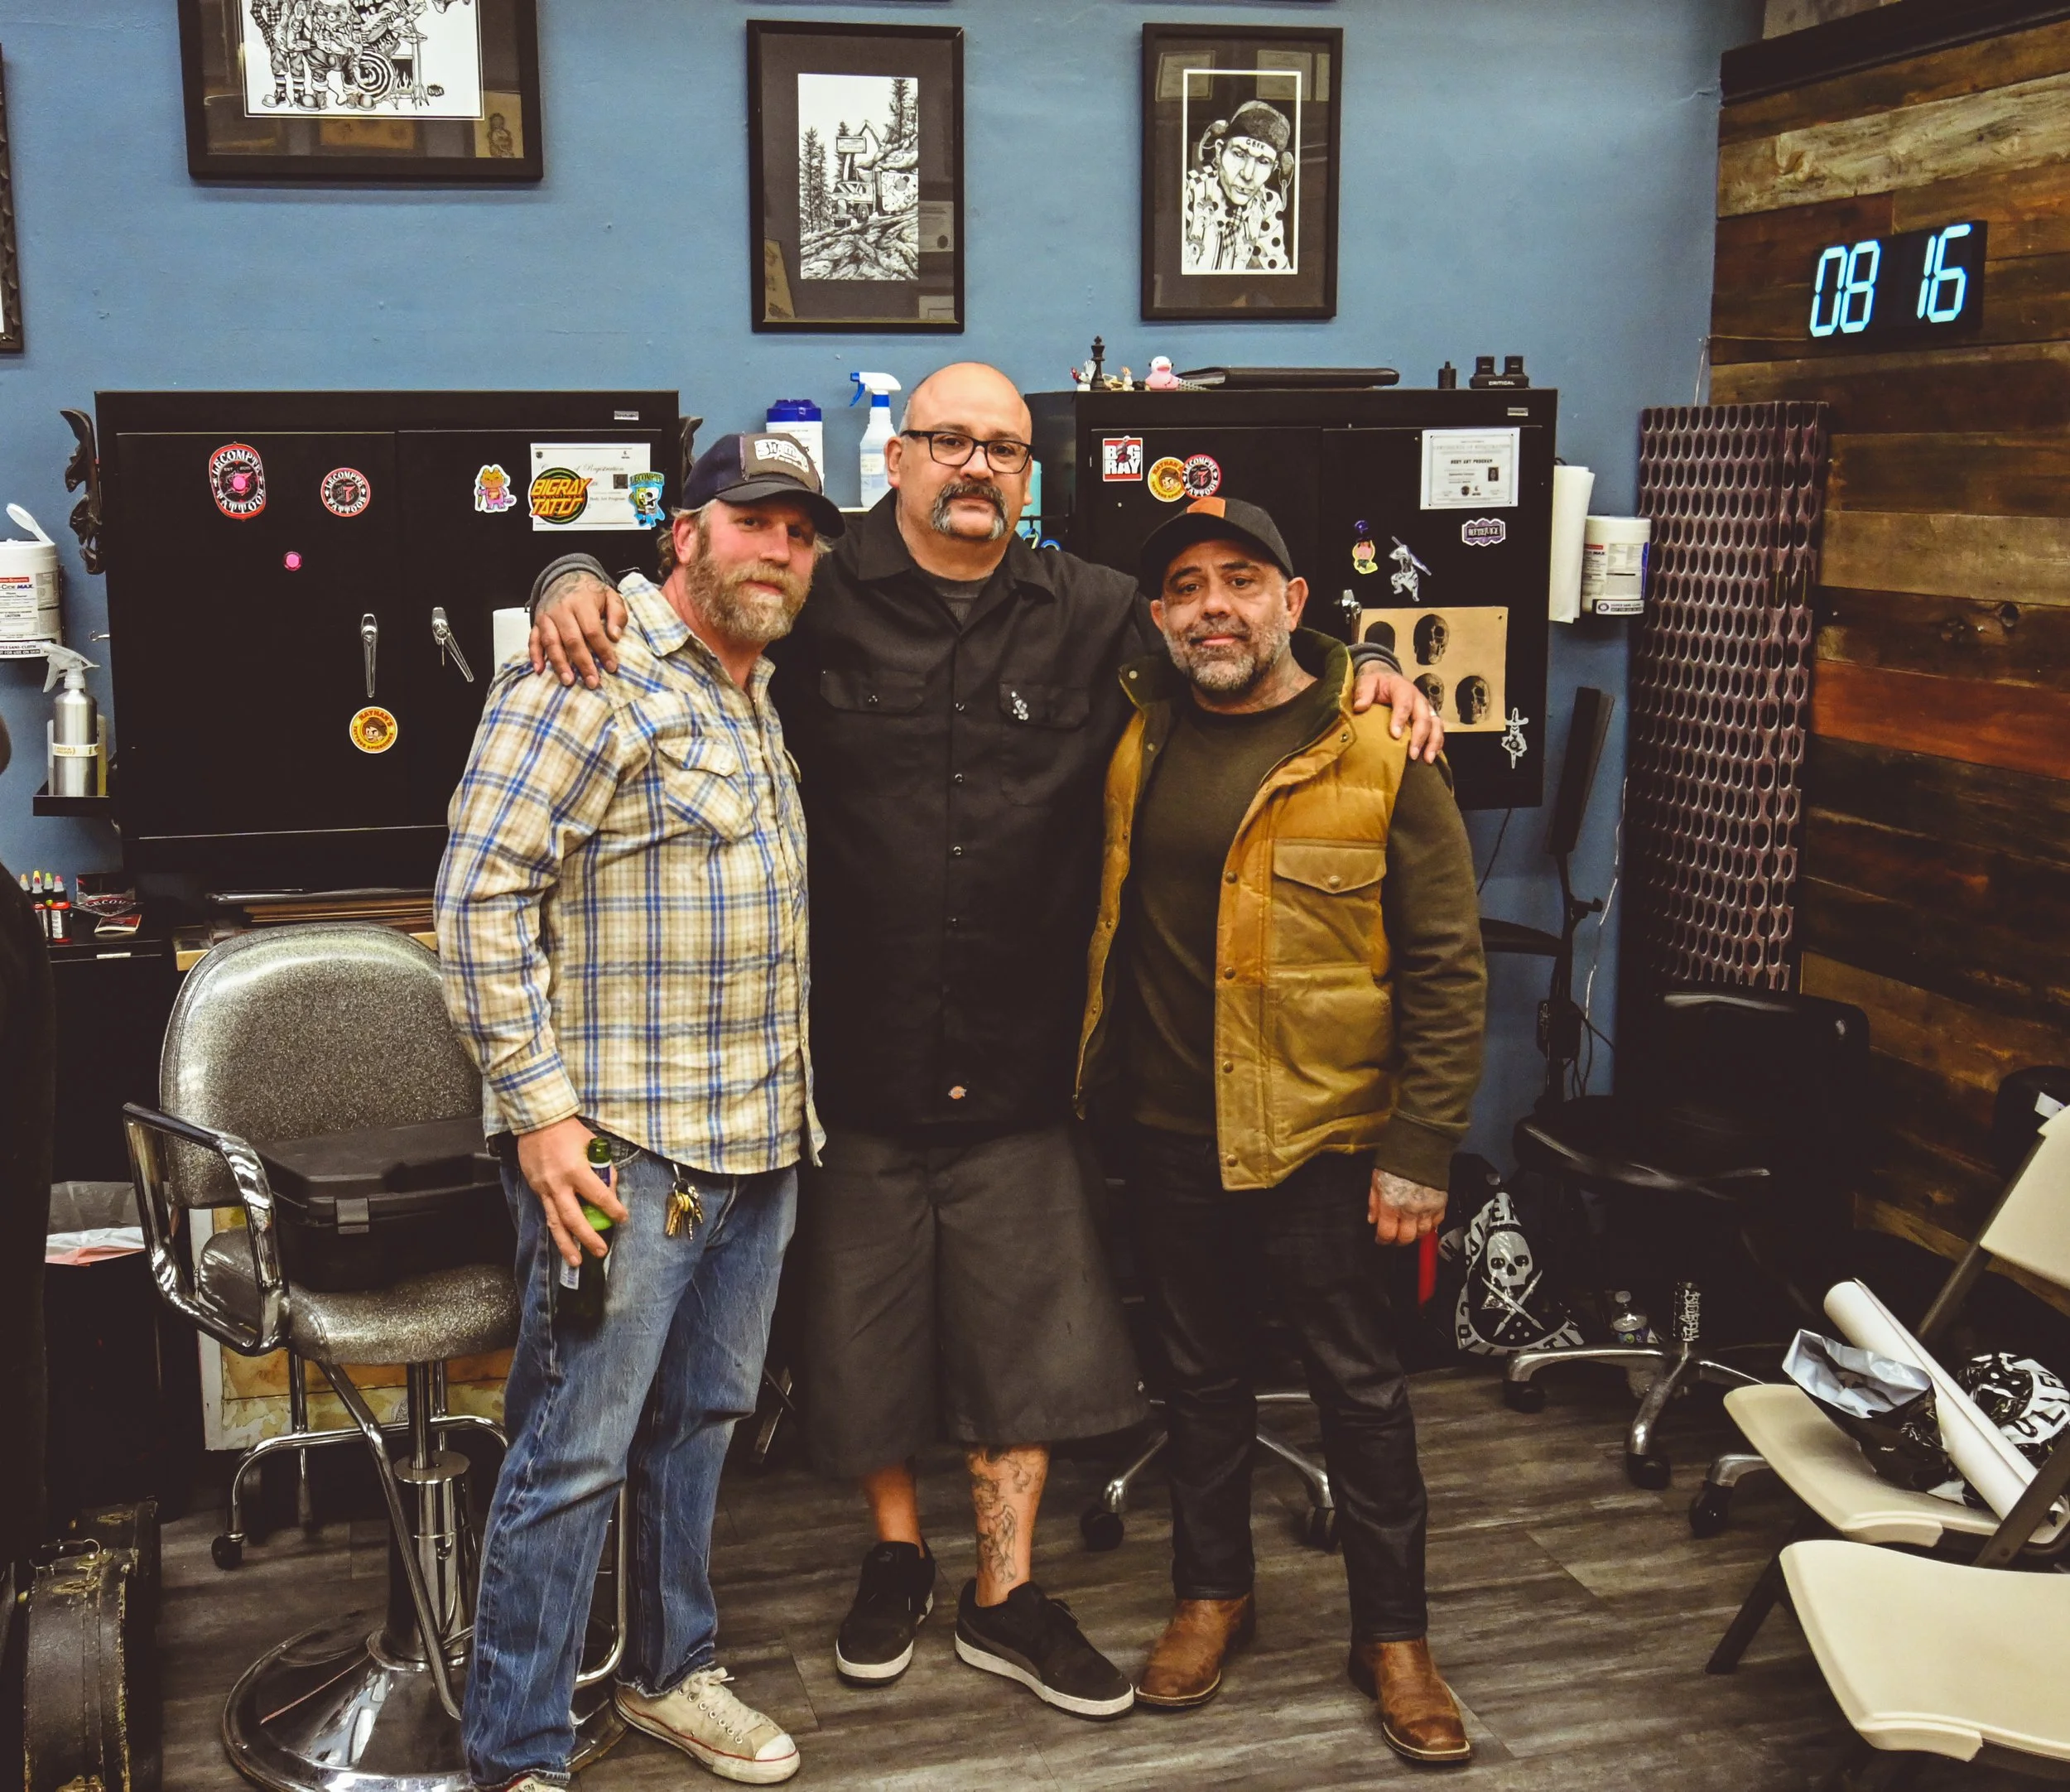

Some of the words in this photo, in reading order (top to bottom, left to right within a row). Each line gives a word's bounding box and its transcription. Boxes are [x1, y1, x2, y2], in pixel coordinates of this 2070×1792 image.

[1809, 238, 1880, 338] 08
[1916, 223, 1972, 324] 16
[211, 450, 261, 475] LECOMPTE
[583, 463, 624, 474] Registration
[1105, 458, 1141, 474] RAY
[1182, 457, 1217, 474] LECOMPTE
[324, 470, 365, 489] LECOMPTE
[530, 477, 594, 496] BIGRAY
[629, 474, 663, 484] LECOMPTE
[1186, 480, 1219, 498] TATTOOS
[216, 488, 265, 514] TATTOOS
[326, 496, 367, 514] TATTOOS
